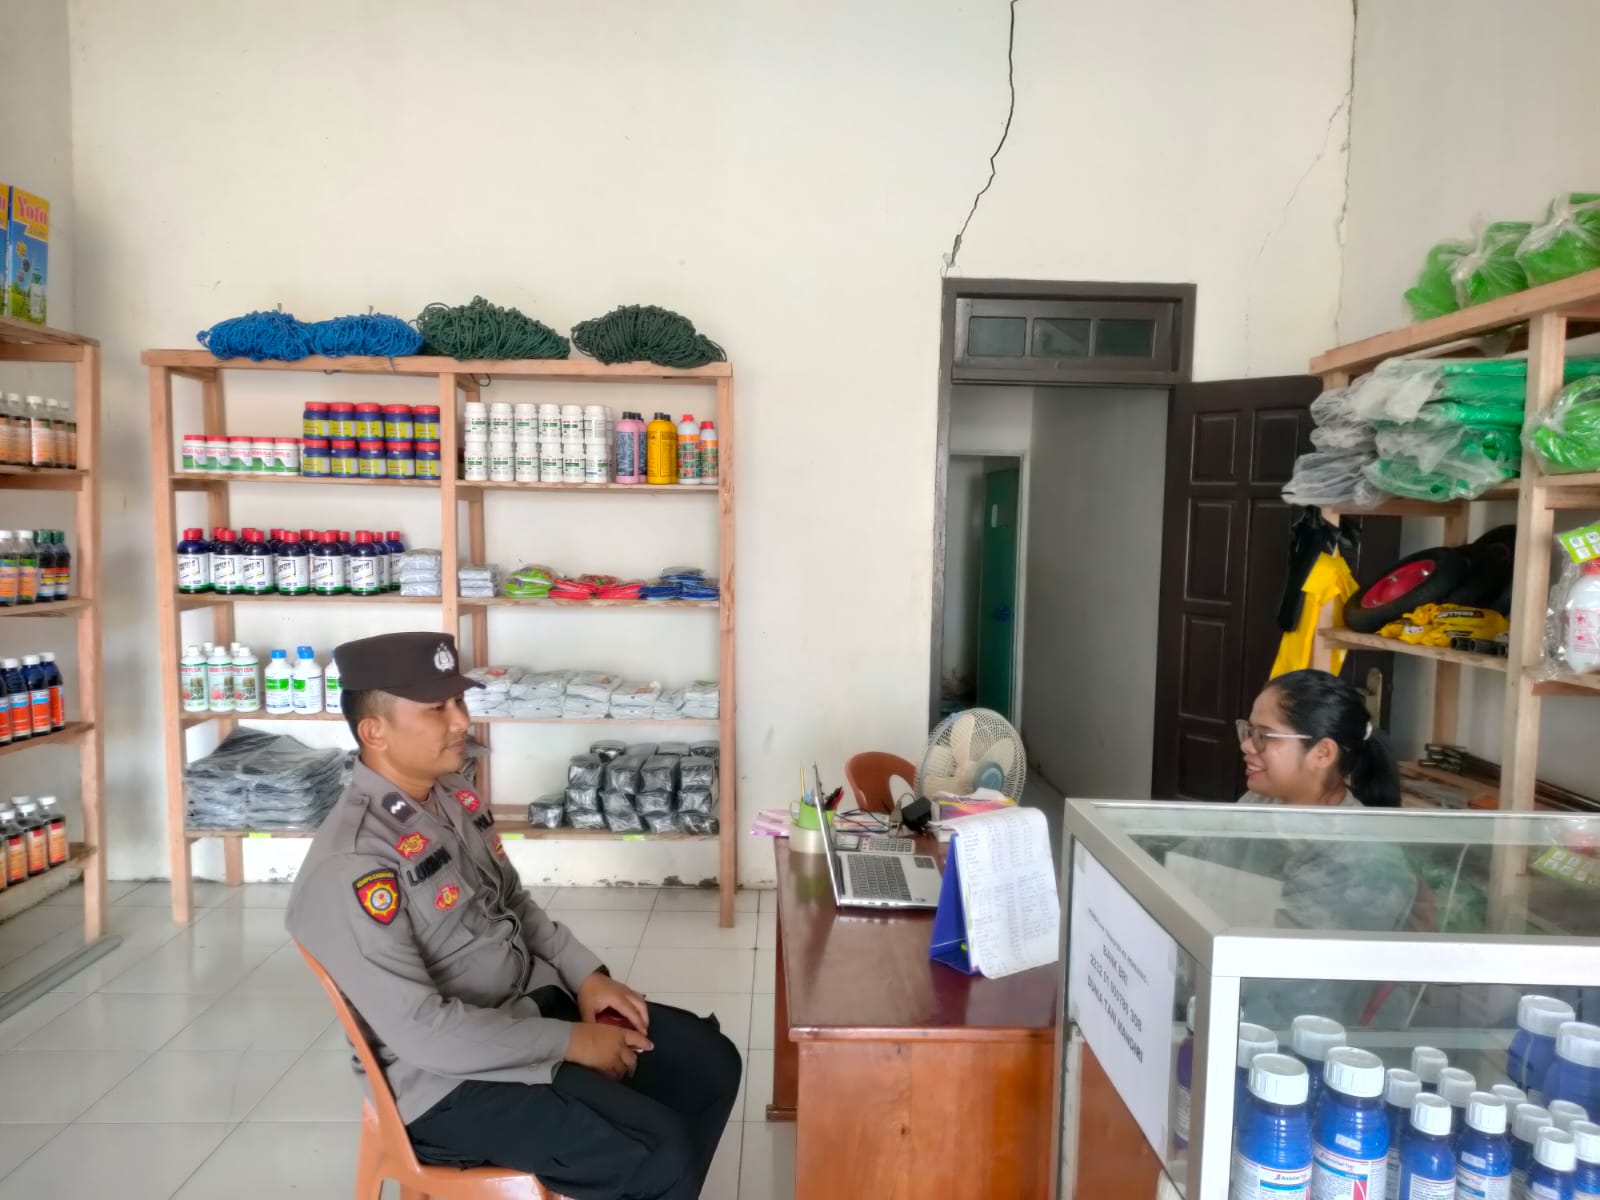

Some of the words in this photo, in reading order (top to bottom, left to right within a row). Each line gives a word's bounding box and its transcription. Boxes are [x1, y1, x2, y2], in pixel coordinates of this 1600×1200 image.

[1102, 943, 1117, 972] BANK
[1118, 964, 1128, 987] BRI
[1087, 974, 1103, 1004] DUNIA
[1103, 998, 1117, 1026] TANI
[1117, 1017, 1143, 1065] MANDIRI
